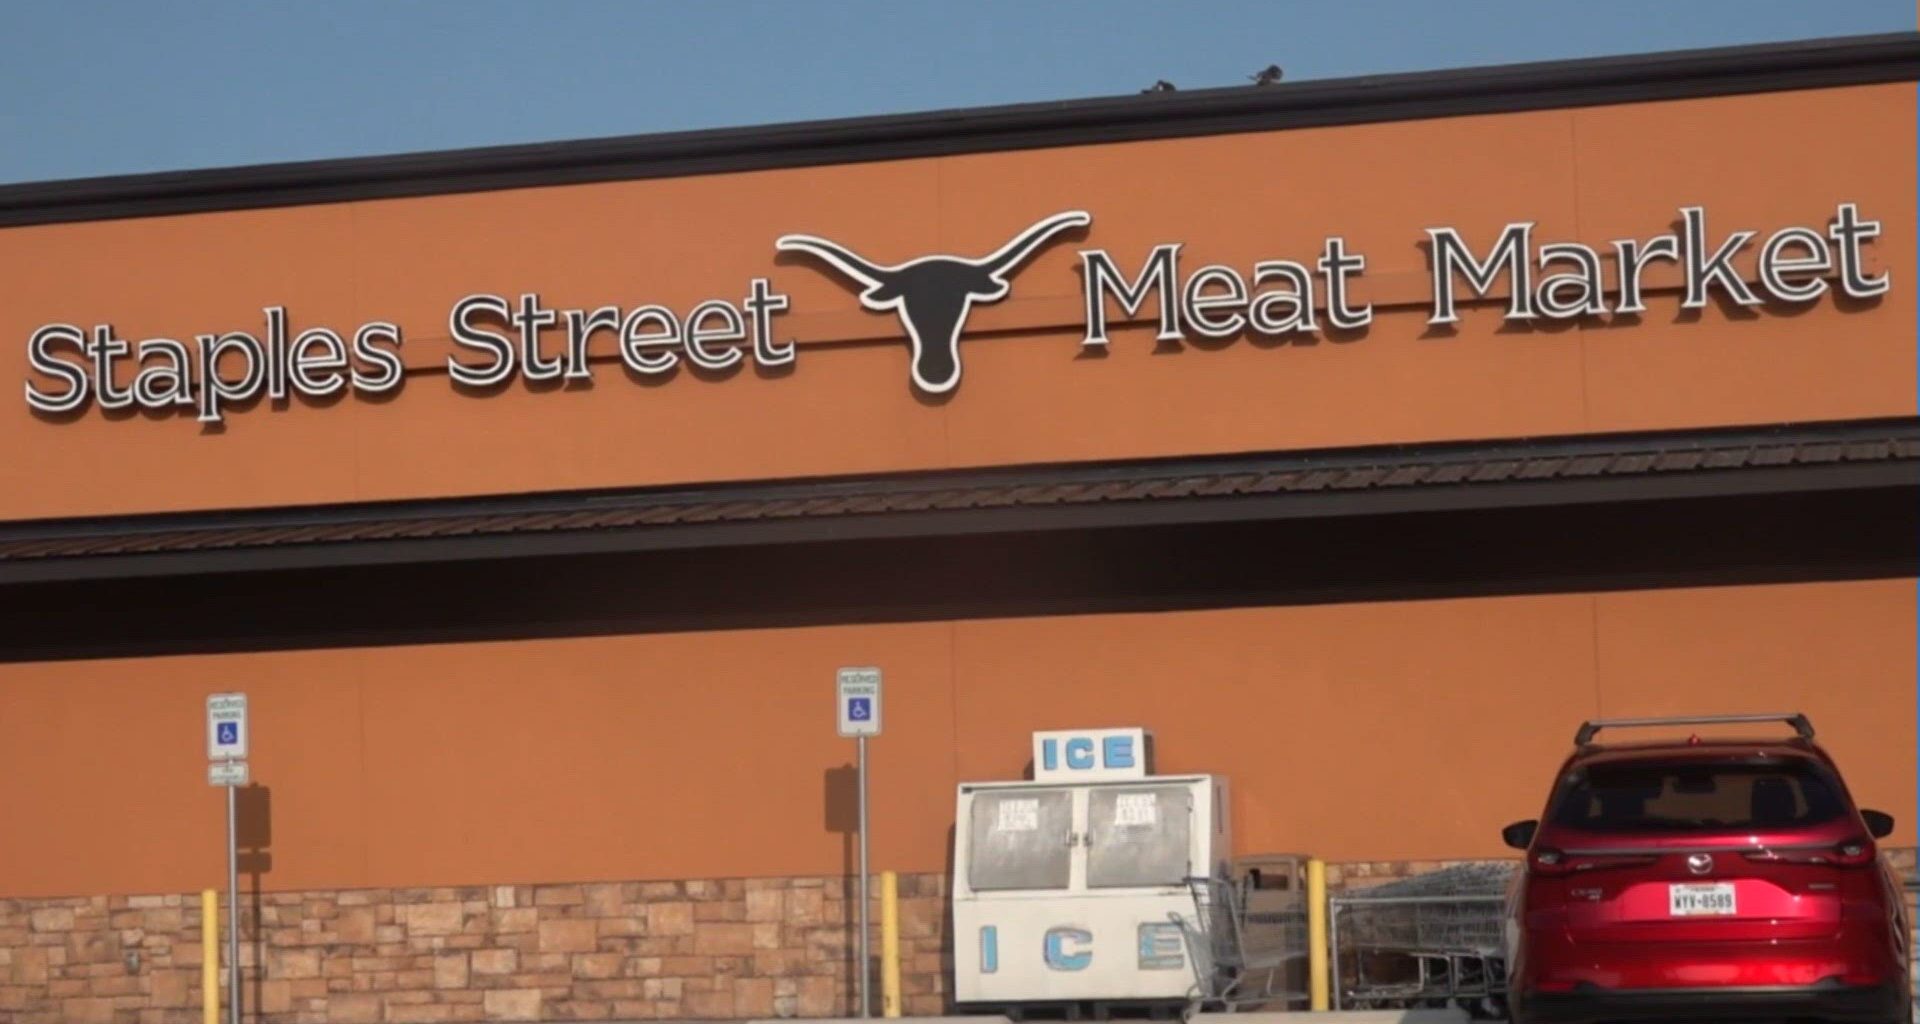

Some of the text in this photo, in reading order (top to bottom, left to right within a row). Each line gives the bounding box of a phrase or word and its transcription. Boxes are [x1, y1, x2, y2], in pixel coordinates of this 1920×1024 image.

[25, 203, 1890, 422] Staples Street Meat Market
[1042, 736, 1135, 771] ICE
[979, 922, 1185, 973] ICE
